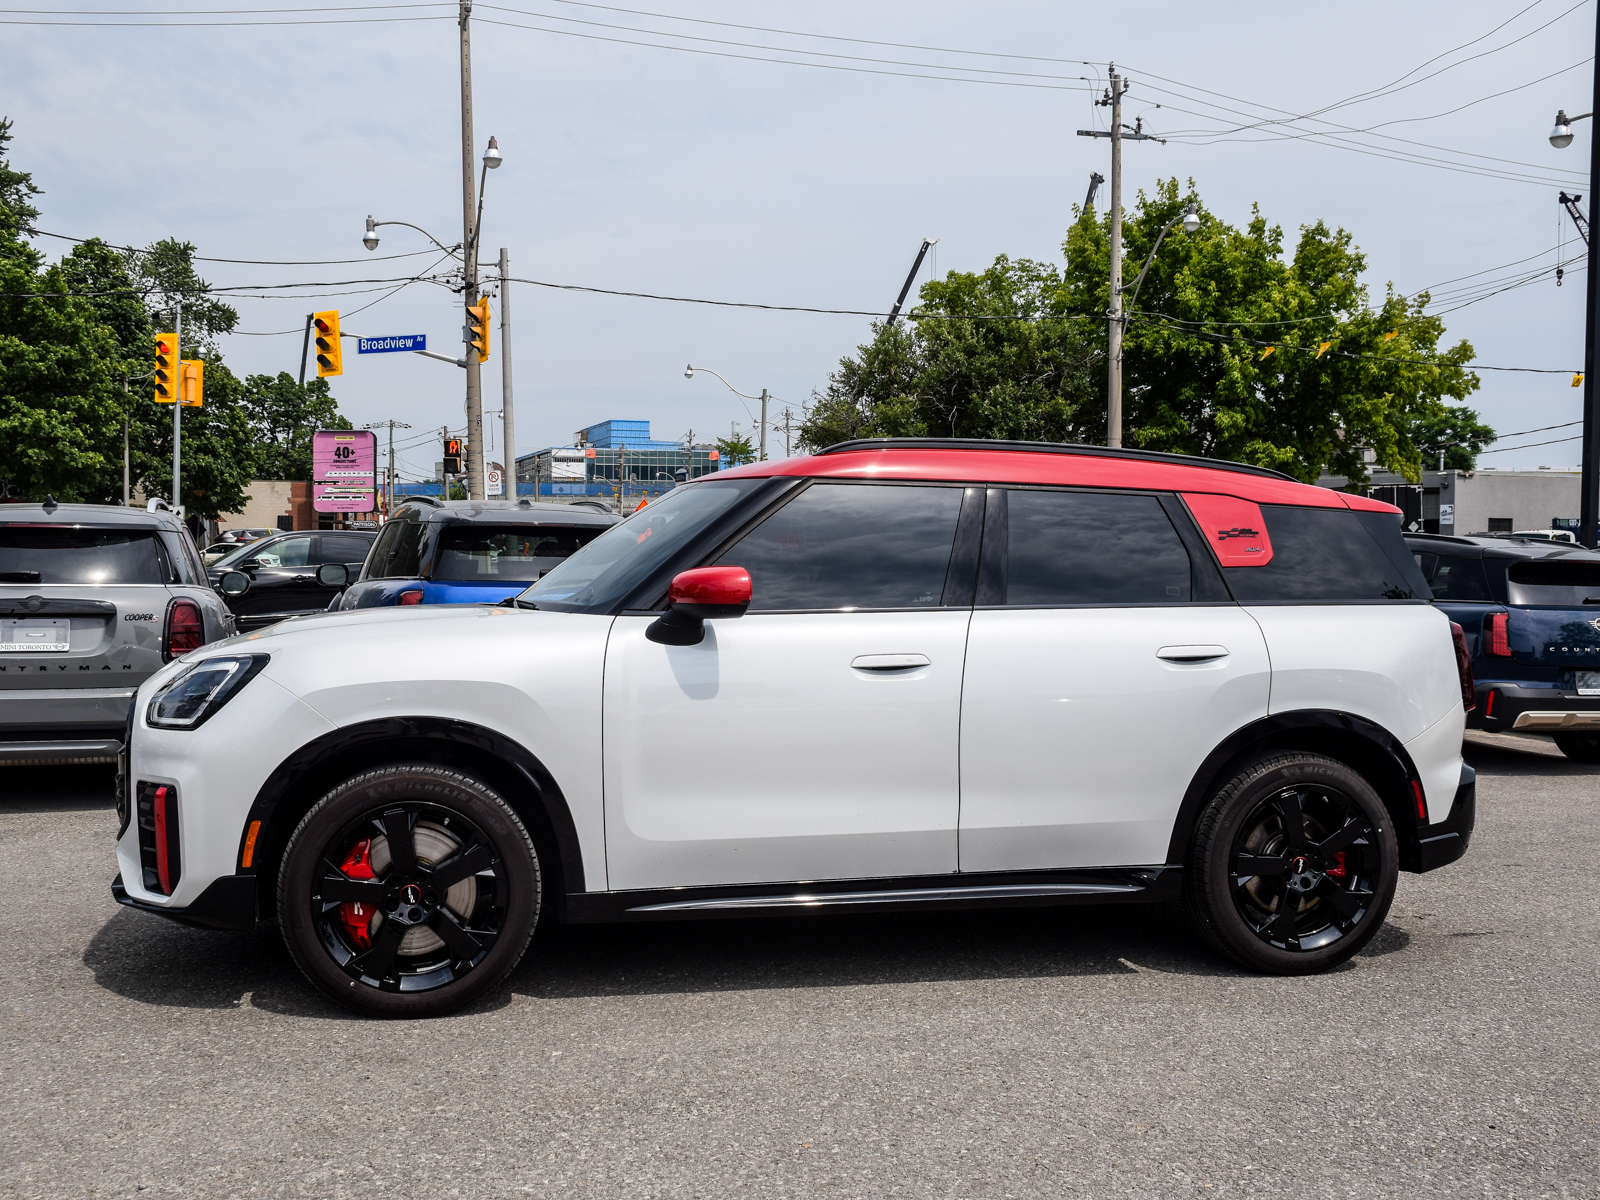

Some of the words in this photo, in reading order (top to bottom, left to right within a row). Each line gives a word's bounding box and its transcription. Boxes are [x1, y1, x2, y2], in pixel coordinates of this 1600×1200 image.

[361, 337, 413, 350] Broadview
[334, 446, 356, 459] 40+
[124, 614, 153, 622] COOPER
[394, 782, 469, 801] MICHELIN
